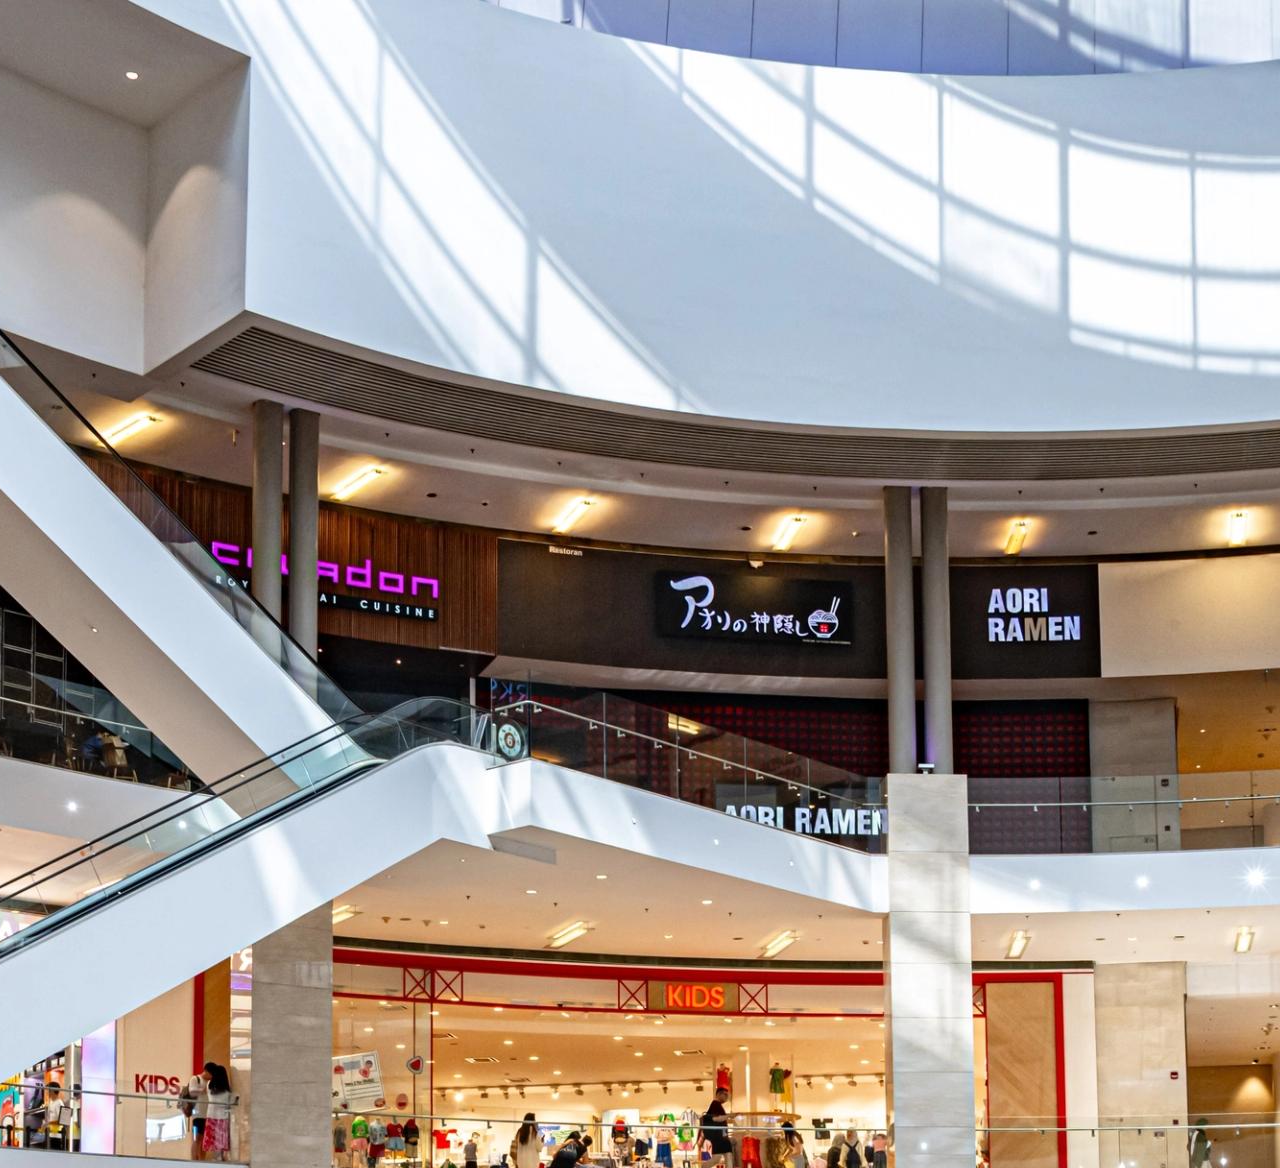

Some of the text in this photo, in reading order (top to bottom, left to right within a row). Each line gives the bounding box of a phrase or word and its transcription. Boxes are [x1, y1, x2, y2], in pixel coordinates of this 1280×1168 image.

[359, 599, 437, 619] CUISINE
[988, 587, 1049, 614] AORI
[988, 615, 1082, 642] RAMEN
[794, 806, 889, 836] RAMEN
[667, 984, 724, 1009] KIDS
[134, 1073, 181, 1096] KIDS
